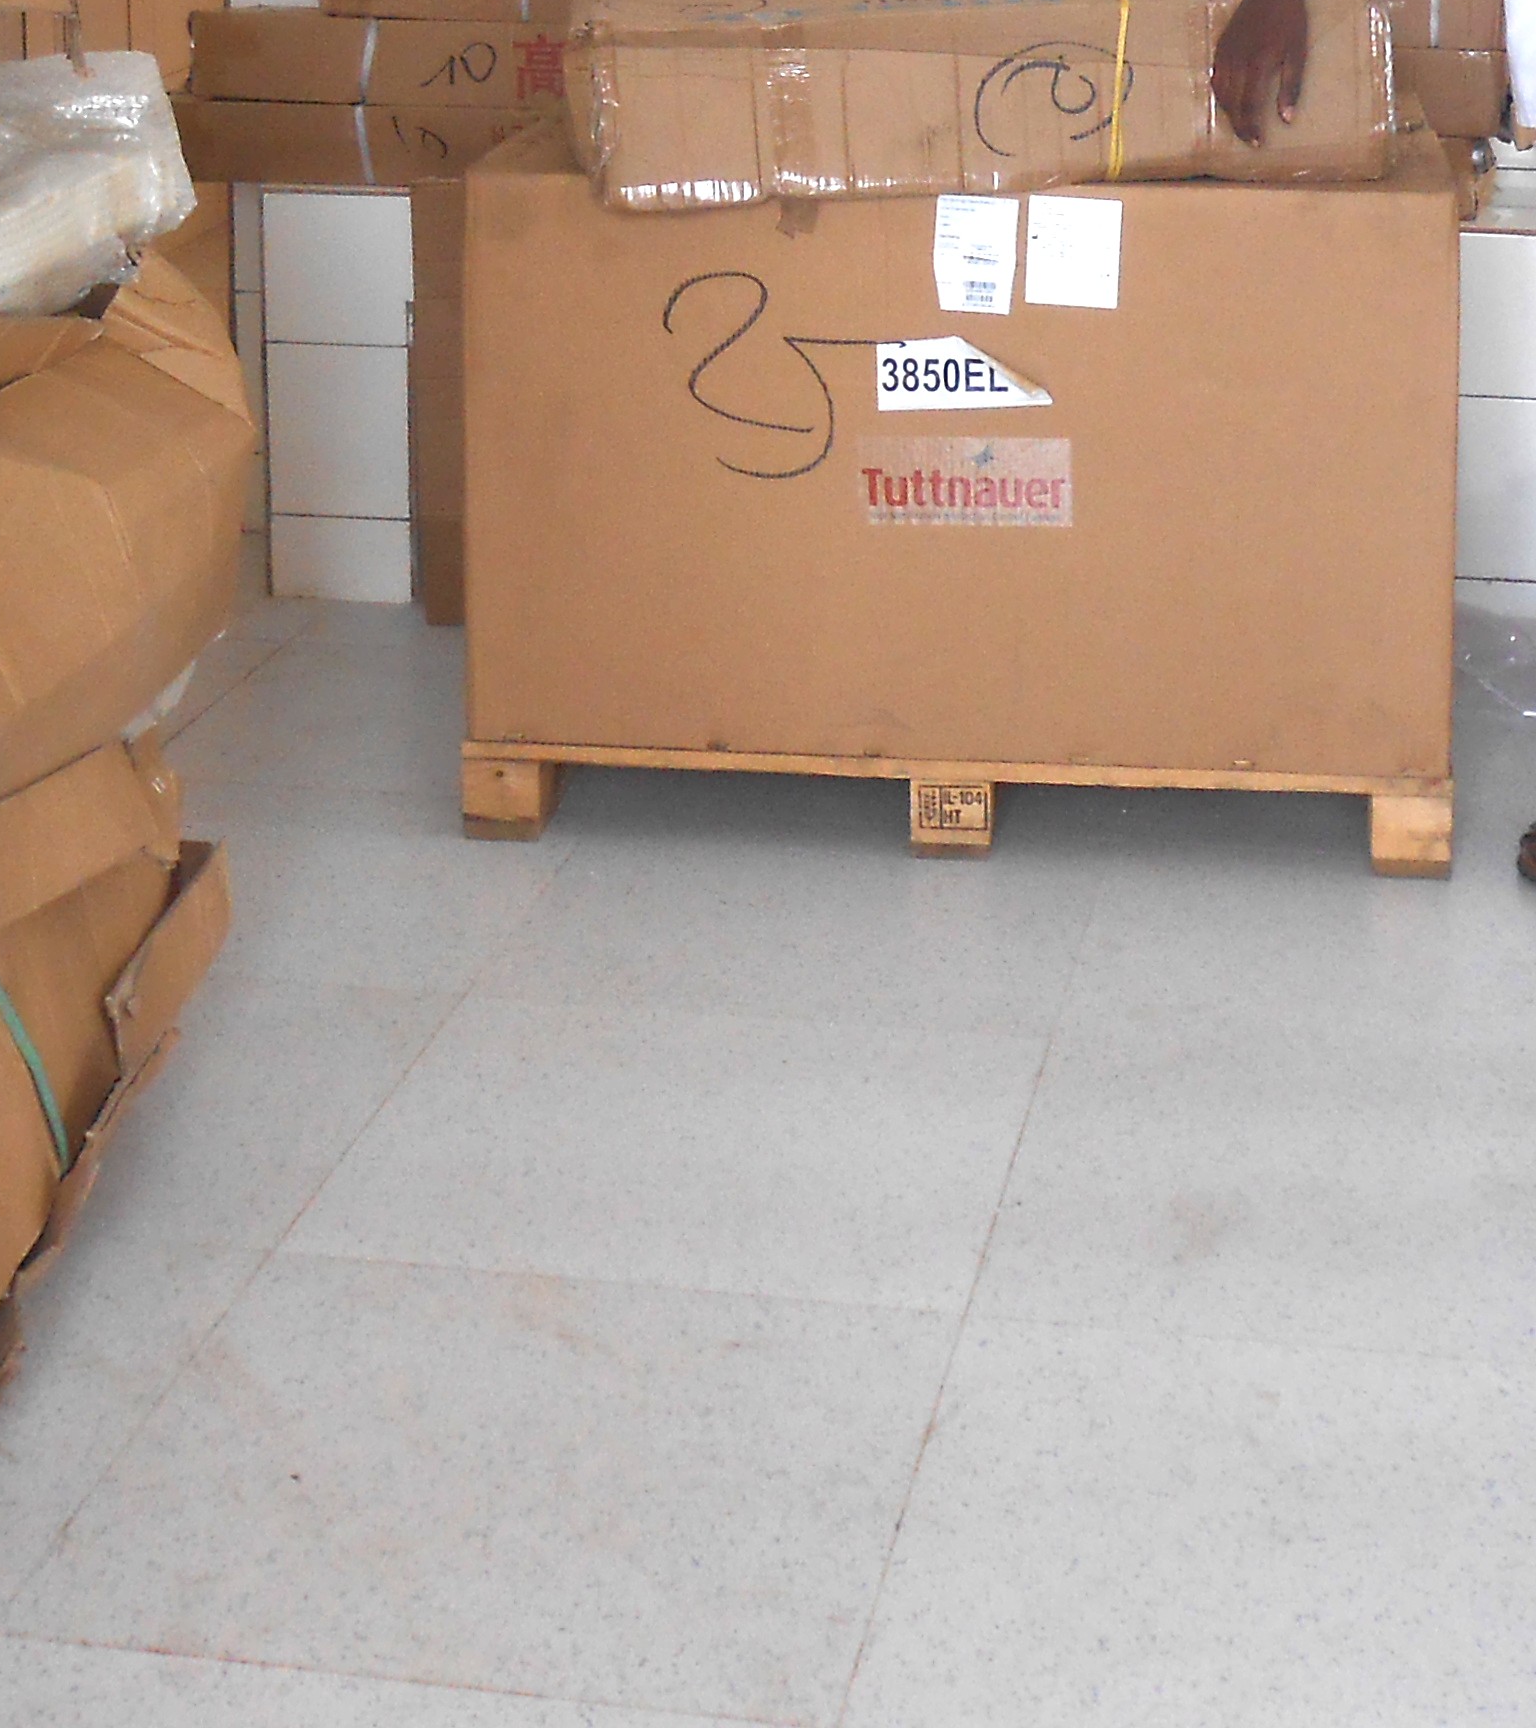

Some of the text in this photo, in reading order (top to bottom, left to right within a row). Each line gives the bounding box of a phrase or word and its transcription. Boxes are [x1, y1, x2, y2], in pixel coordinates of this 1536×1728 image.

[420, 42, 497, 87] 10
[663, 271, 907, 480] 25
[881, 357, 1009, 393] 3850EL
[861, 467, 1066, 509] Tuttnauer
[943, 809, 962, 824] HT
